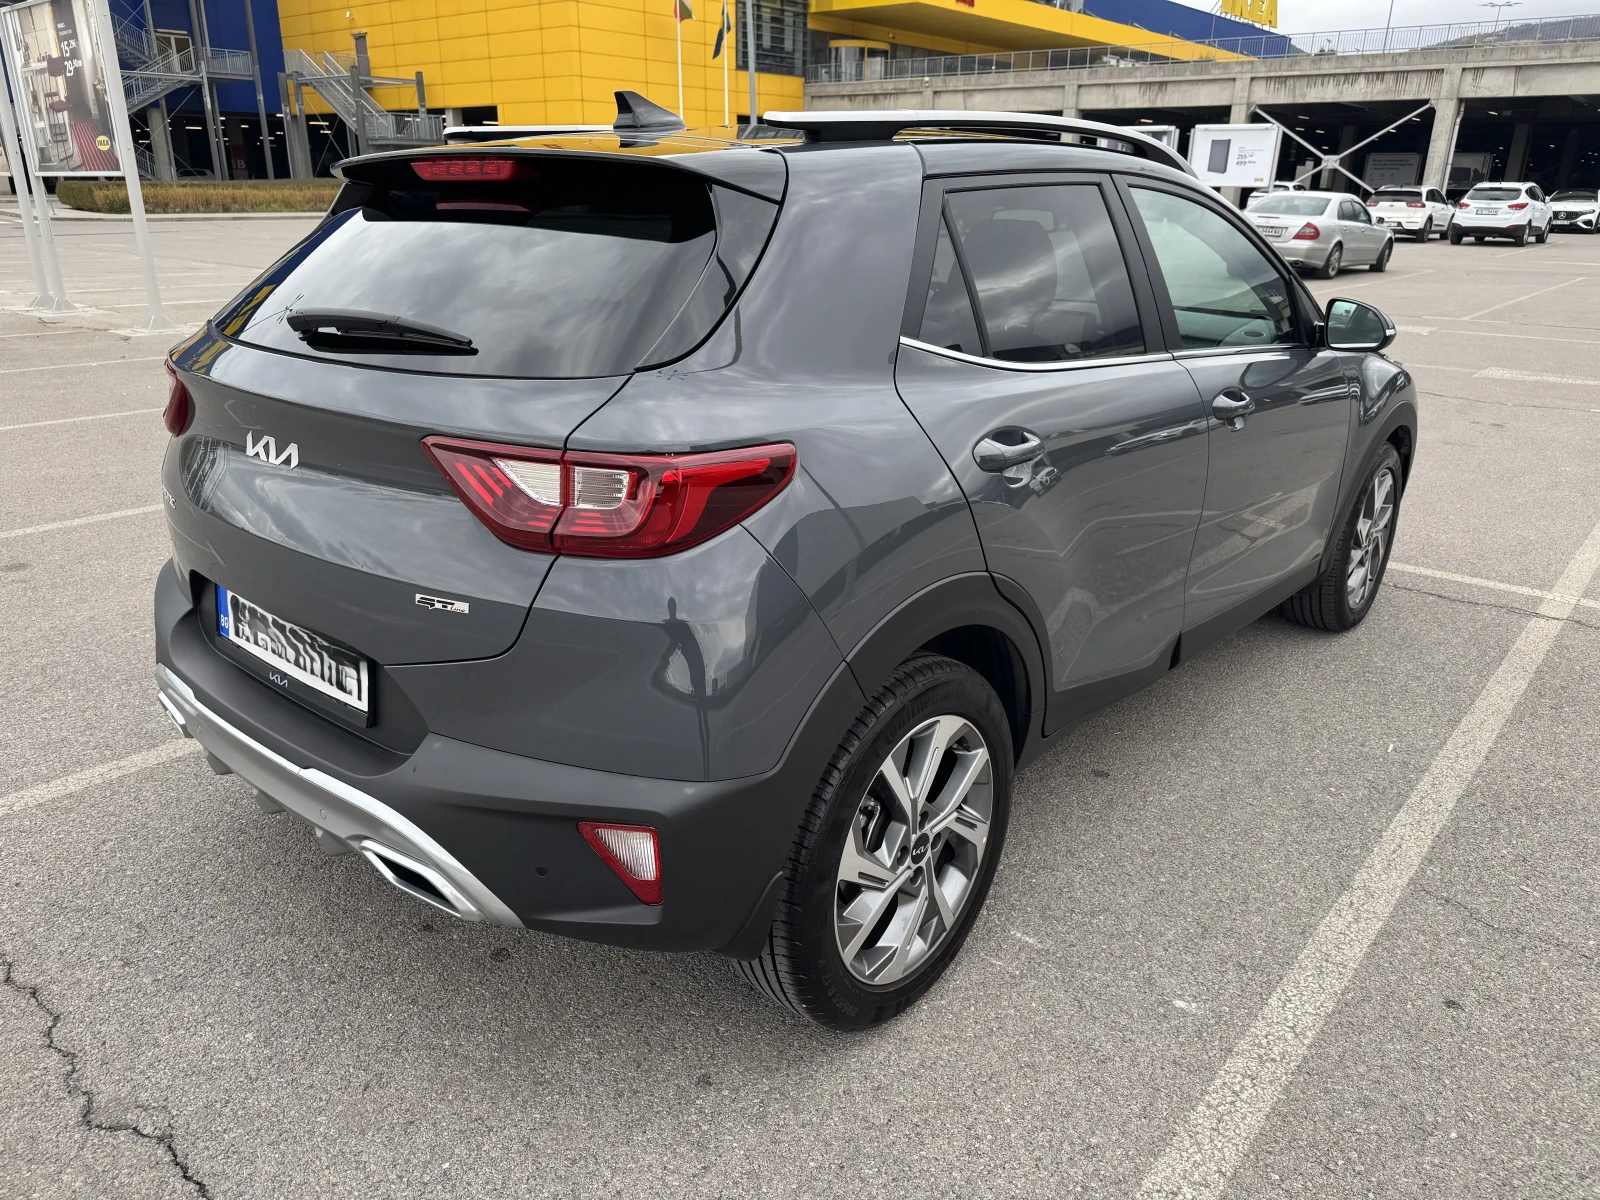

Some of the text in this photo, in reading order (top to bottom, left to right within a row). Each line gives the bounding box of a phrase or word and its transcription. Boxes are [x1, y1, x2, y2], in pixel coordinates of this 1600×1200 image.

[97, 139, 110, 147] IKEA
[246, 431, 299, 470] KIA
[220, 614, 229, 629] BG
[269, 671, 288, 688] KIA
[912, 842, 930, 856] KIA
[832, 993, 859, 1017] 205/55
